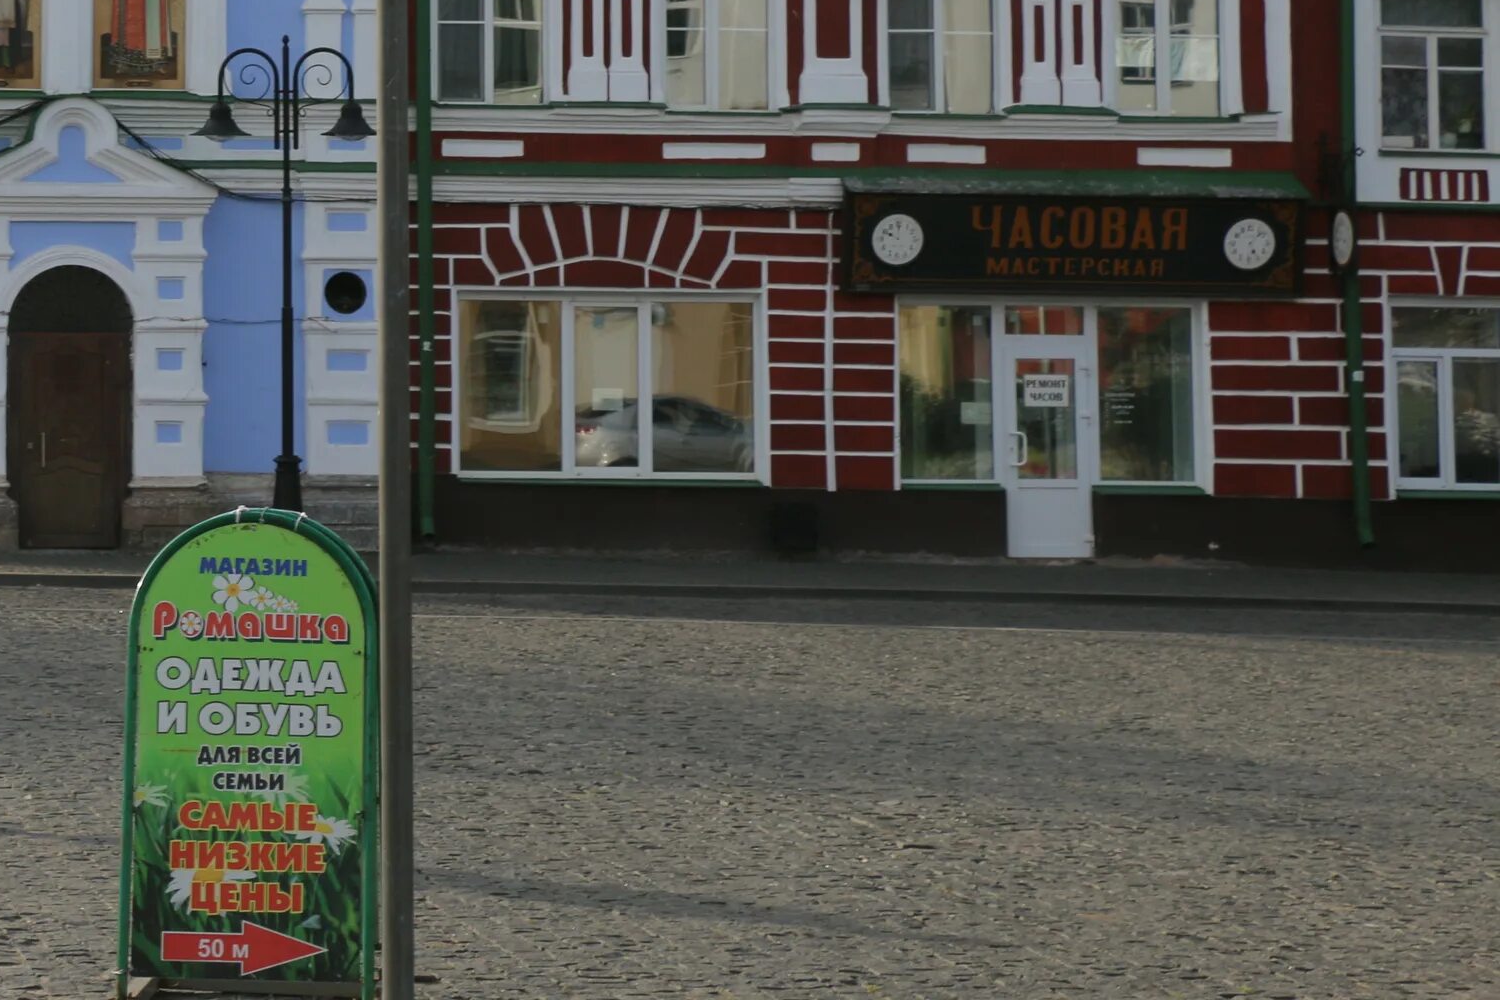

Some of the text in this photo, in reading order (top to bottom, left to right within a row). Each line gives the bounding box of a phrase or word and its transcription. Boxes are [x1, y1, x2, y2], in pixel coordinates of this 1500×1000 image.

[970, 204, 1189, 250] ЧАСОВАЯ
[986, 256, 1164, 277] МАСТЕРСКАЯ
[1026, 379, 1066, 389] РЕМОНТ
[1030, 391, 1063, 401] ЧАСОВ
[199, 557, 308, 577] МАГАЗИН
[152, 600, 350, 644] Ромашка
[156, 656, 347, 697] ОДЕЖДА
[156, 700, 343, 737] И ОБУВЬ
[197, 743, 301, 765] ДЛЯ ВСЕЙ
[212, 772, 285, 791] СЕМЬИ
[178, 800, 318, 832] САМЫЕ
[169, 840, 328, 873] НИЗКИЕ
[190, 881, 304, 916] ЦЕНЫ
[197, 938, 224, 958] 50
